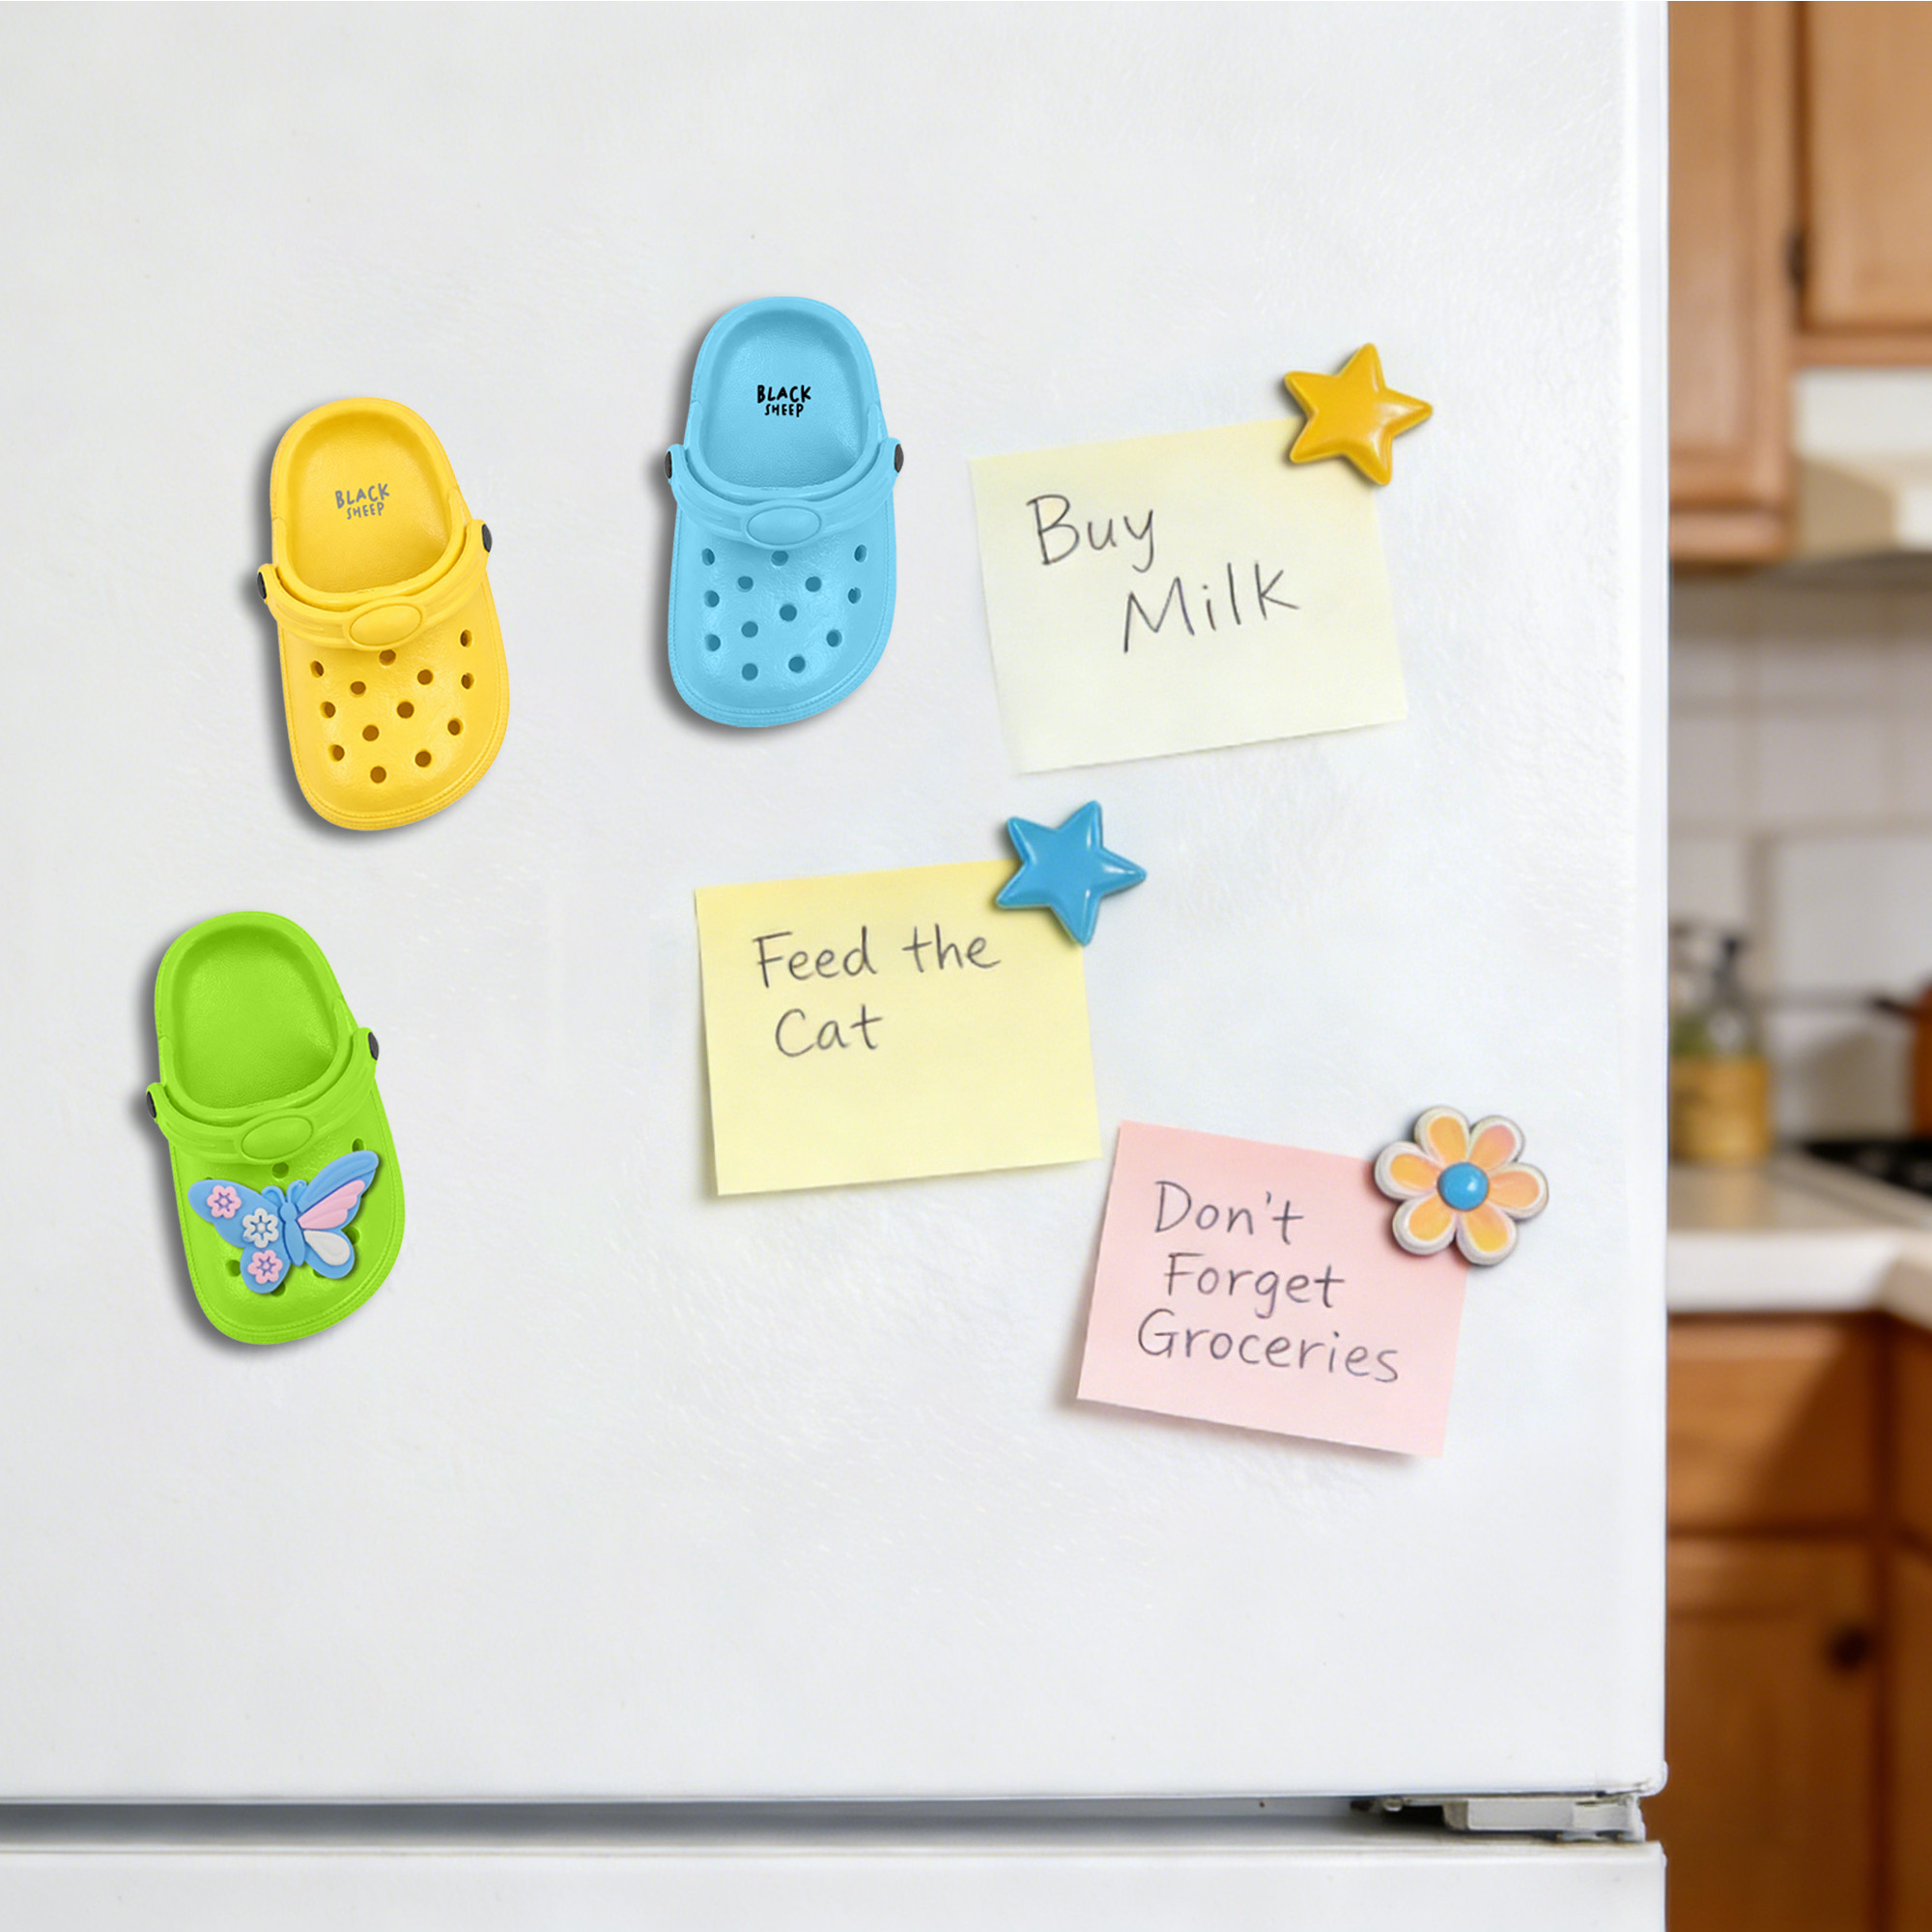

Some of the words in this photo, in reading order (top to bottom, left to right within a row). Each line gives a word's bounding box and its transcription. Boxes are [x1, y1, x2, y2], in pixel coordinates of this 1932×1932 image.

[756, 384, 811, 404] BLACK
[764, 403, 804, 417] SHEEP
[335, 483, 389, 509] BLACK
[347, 502, 384, 520] SHEEP
[1025, 493, 1156, 575] Buy
[1122, 560, 1301, 655] Milk
[751, 923, 878, 989] Feed
[901, 923, 1003, 975] the
[774, 1003, 884, 1059] Cat
[1153, 1179, 1305, 1246] Don't
[1163, 1251, 1347, 1321] Forget
[1136, 1307, 1400, 1383] Groceries
